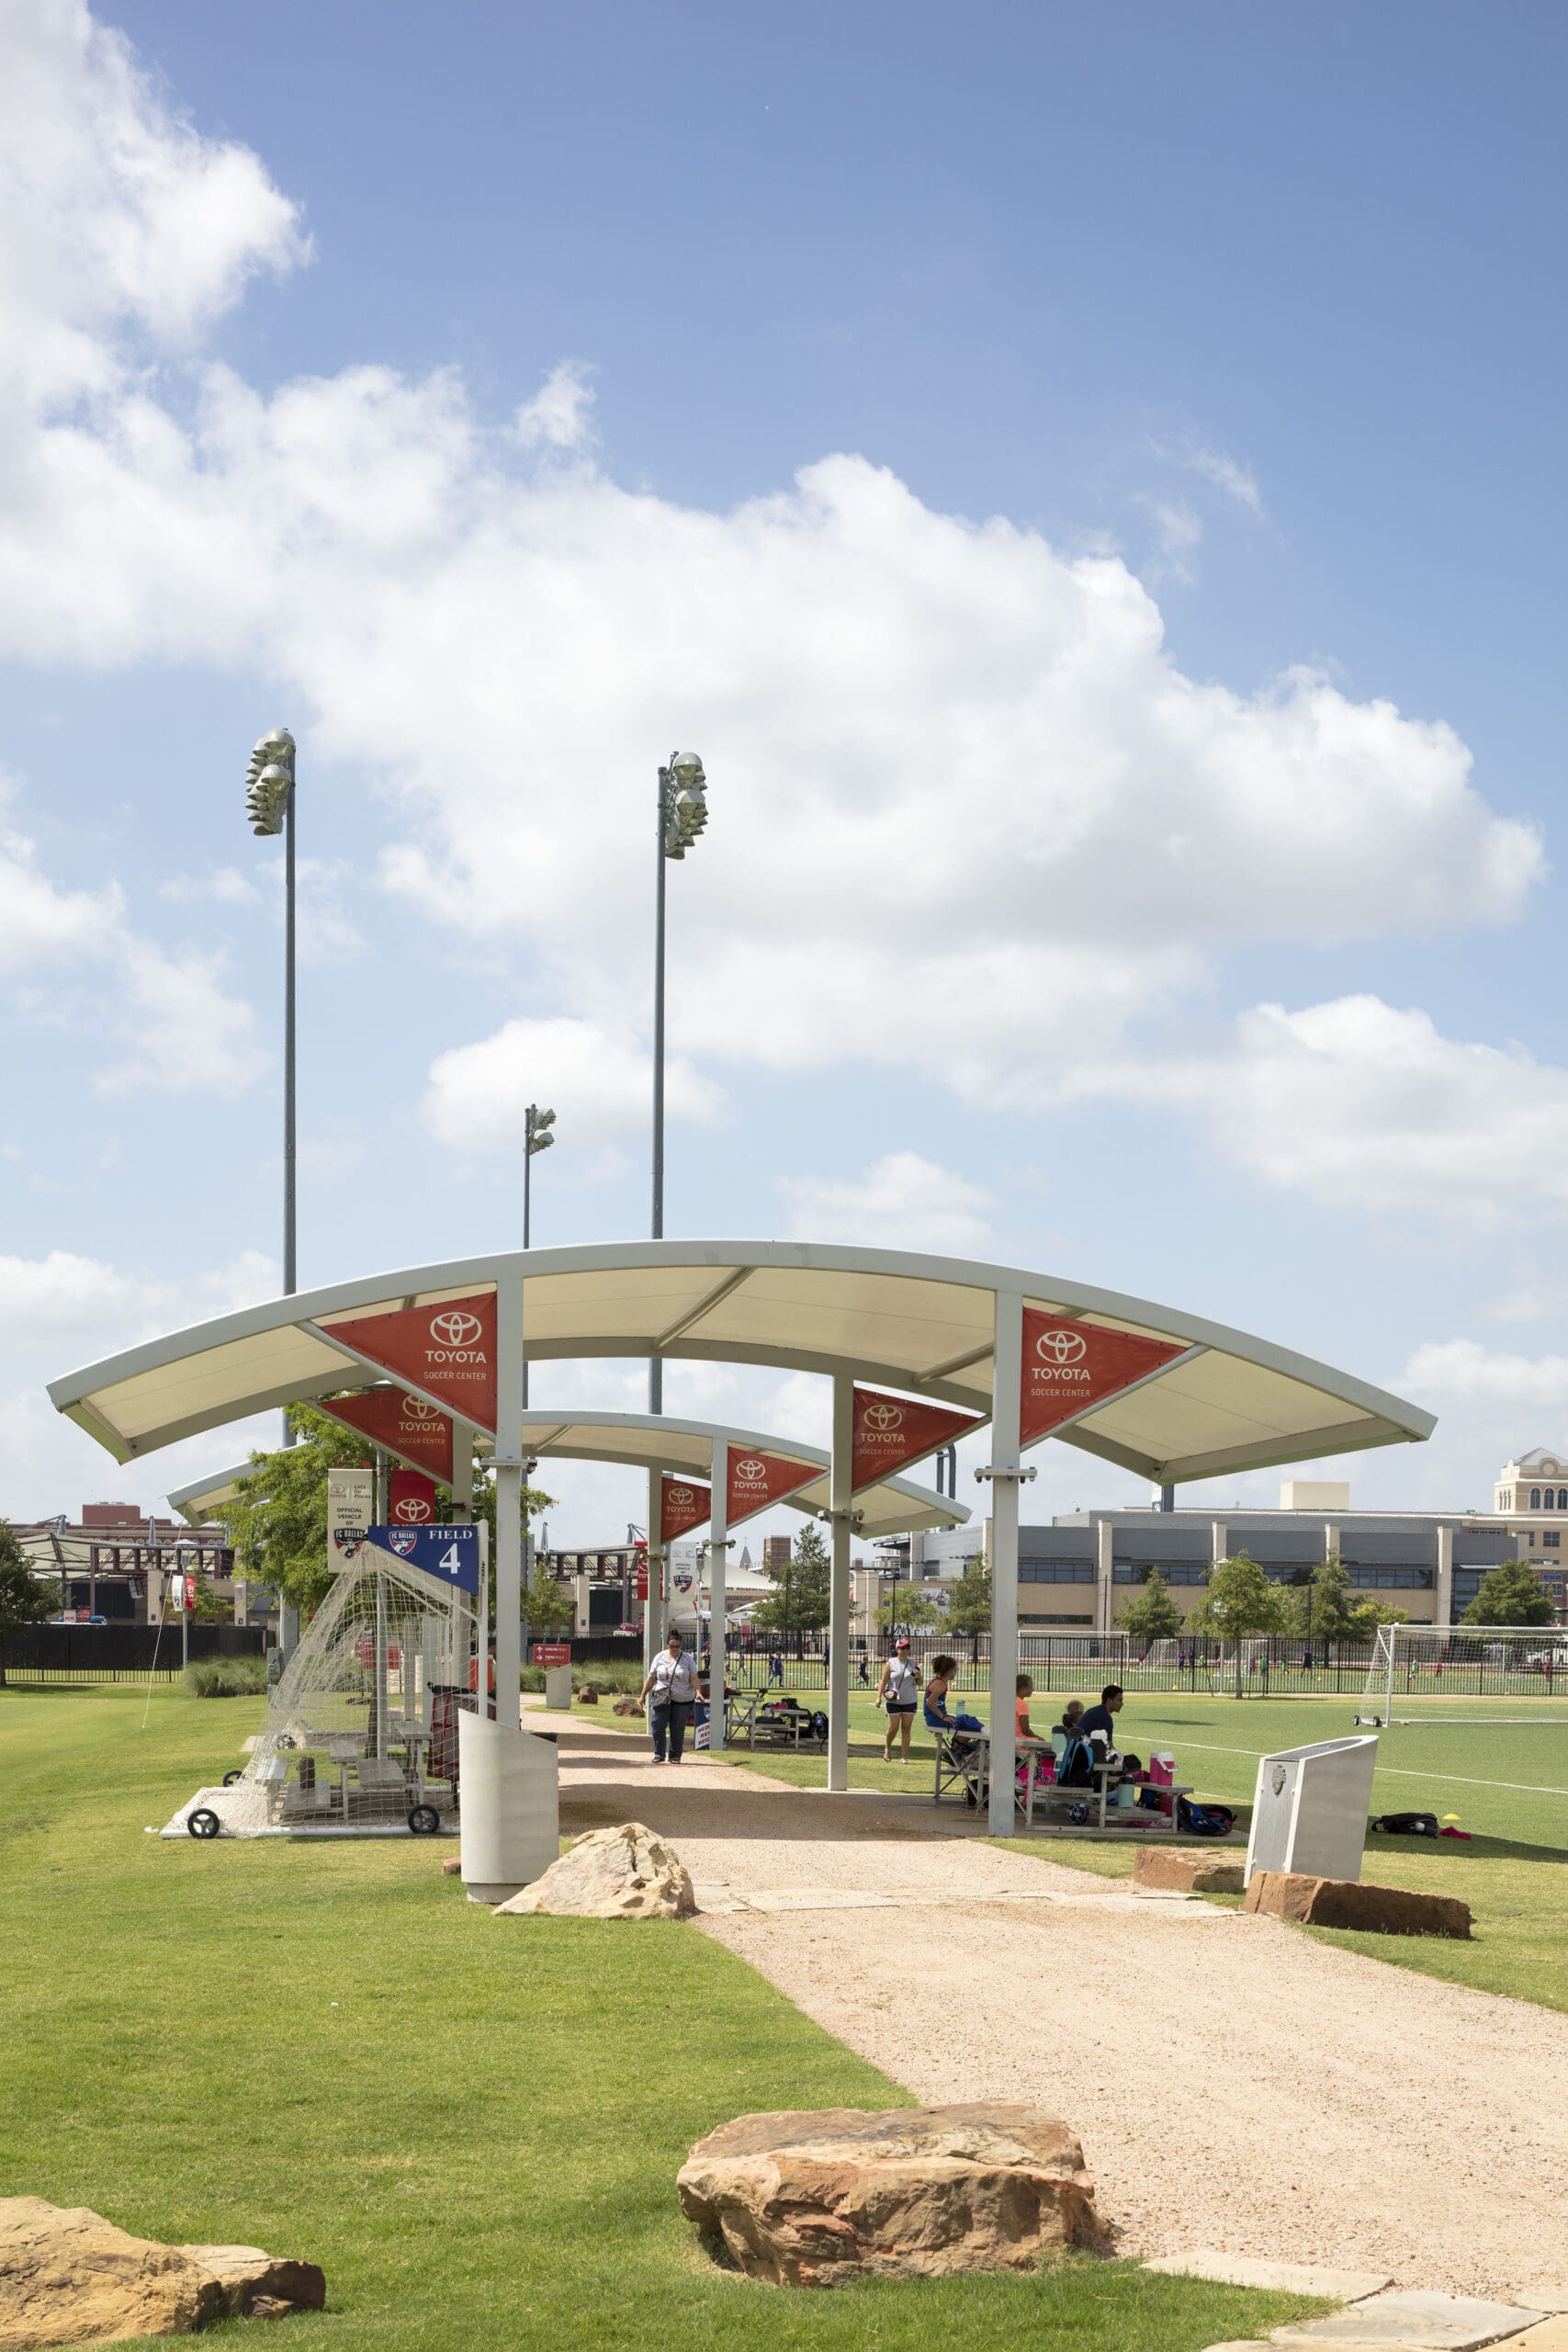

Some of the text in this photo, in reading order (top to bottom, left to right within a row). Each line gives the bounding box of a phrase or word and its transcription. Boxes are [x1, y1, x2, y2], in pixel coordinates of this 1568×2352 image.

[424, 1350, 487, 1363] TOYOTA
[423, 1371, 487, 1380] SOCCER CENTER
[1032, 1367, 1091, 1381] TOYOTA
[1031, 1388, 1090, 1397] SOCCER CENTER
[398, 1421, 446, 1432] TOYOTA
[860, 1432, 906, 1442] TOYOTA
[733, 1481, 769, 1490] TOYOTA
[335, 1529, 365, 1538] FC DALLAS
[428, 1530, 473, 1540] FIELD
[439, 1543, 461, 1574] 4
